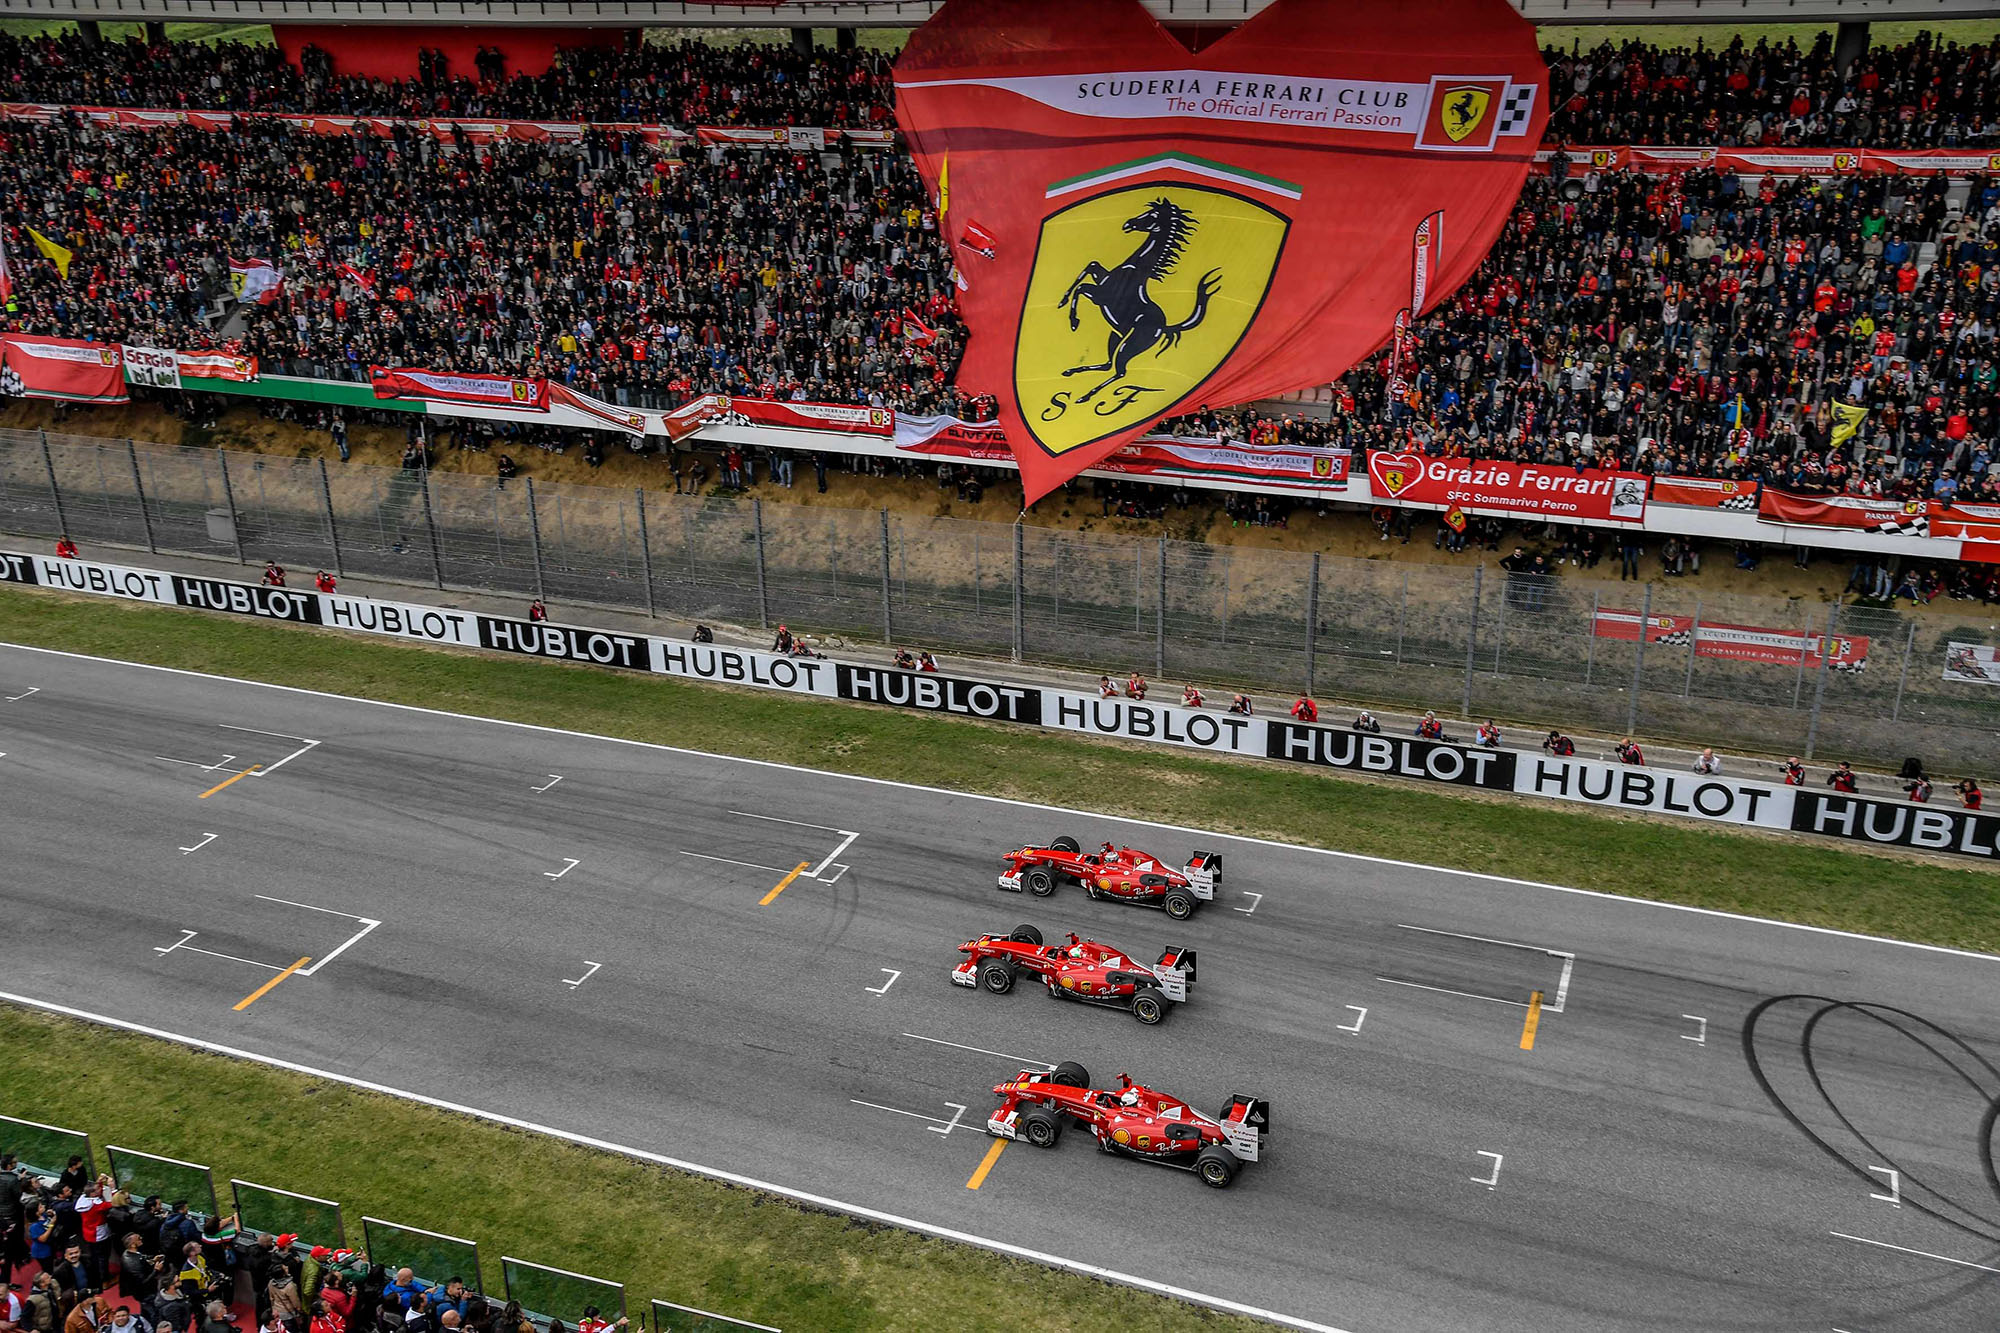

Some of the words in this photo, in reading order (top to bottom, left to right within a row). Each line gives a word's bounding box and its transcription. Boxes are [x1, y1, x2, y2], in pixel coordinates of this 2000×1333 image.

[1077, 79, 1201, 99] SCUDERIA
[1215, 80, 1324, 103] FERRARI
[1338, 88, 1409, 108] CLUB
[1166, 97, 1196, 112] The
[1201, 98, 1264, 117] Official
[1269, 103, 1328, 122] Ferrari
[1333, 108, 1402, 127] Passion
[1040, 391, 1072, 422] S
[1093, 384, 1165, 416] F
[1286, 457, 1308, 465] CLUB
[1427, 461, 1511, 488] Grazie
[1518, 468, 1613, 496] Ferrari
[1446, 490, 1471, 503] SFC
[1474, 493, 1539, 509] Sommariva
[1541, 499, 1578, 512] Perno
[1865, 512, 1896, 521] PARMA
[43, 560, 161, 600] HUBLOT
[182, 581, 309, 621] HUBLOT
[331, 599, 465, 643] HUBLOT
[487, 620, 636, 667] HUBLOT
[662, 643, 820, 693] HUBLOT
[851, 668, 1026, 720] HUBLOT
[1058, 695, 1249, 750] HUBLOT
[1285, 726, 1497, 785] HUBLOT
[1534, 760, 1772, 823] HUBLOT
[1813, 797, 2000, 856] HUBL
